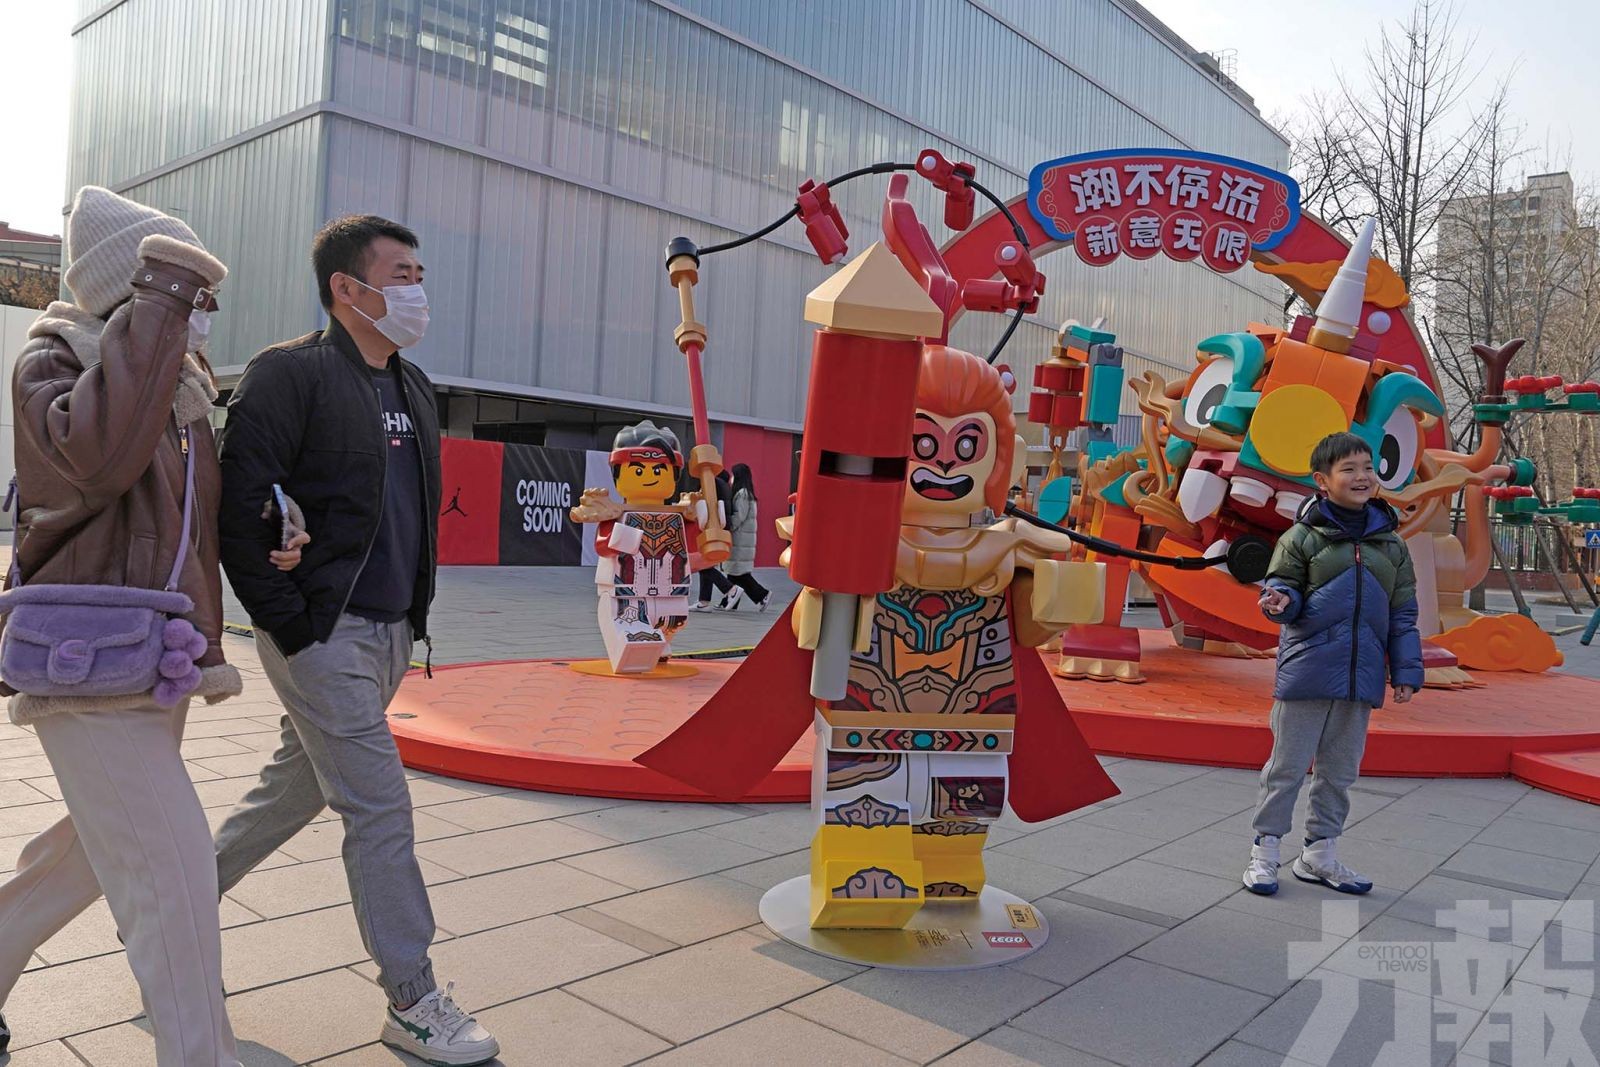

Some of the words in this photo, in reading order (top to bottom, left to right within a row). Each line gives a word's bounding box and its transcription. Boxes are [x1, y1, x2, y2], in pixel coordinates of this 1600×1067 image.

[1069, 163, 1264, 223] 潮不停流
[1085, 216, 1247, 263] 新意无限
[516, 479, 571, 507] COMING
[523, 507, 563, 533] SOON
[990, 936, 1026, 944] LEGO
